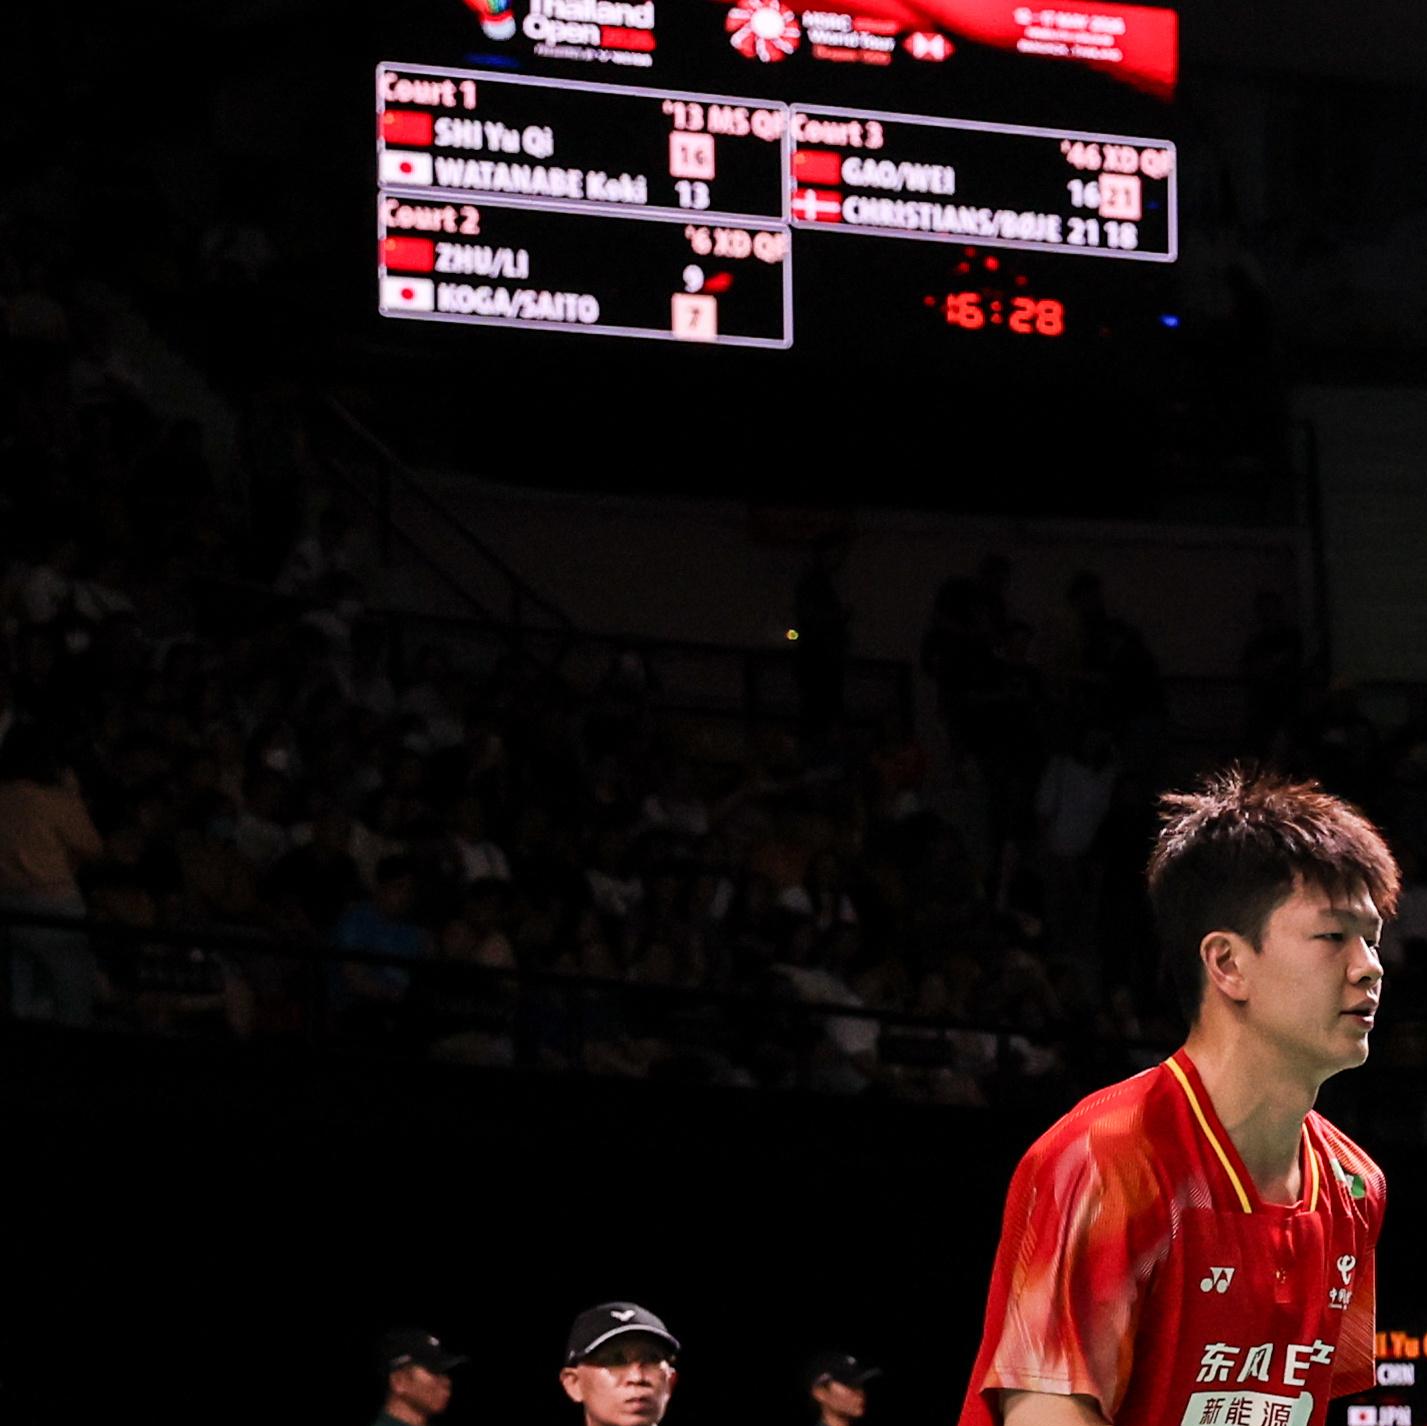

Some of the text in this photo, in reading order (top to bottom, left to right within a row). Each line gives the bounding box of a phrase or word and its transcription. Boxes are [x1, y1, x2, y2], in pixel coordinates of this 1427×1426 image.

[522, 13, 600, 46] Open
[384, 72, 476, 109] Court 1
[434, 117, 483, 150] SHI
[522, 125, 554, 159] Qi
[791, 114, 883, 149] Court 3
[434, 156, 584, 199] WATANABE
[674, 180, 710, 210] 13
[1067, 179, 1100, 209] 16
[386, 199, 480, 235] Court 2
[1066, 216, 1138, 250] 21 18
[435, 242, 529, 279] ZHU/LI
[682, 264, 704, 293] 9
[437, 283, 600, 324] KOGA/SAITO
